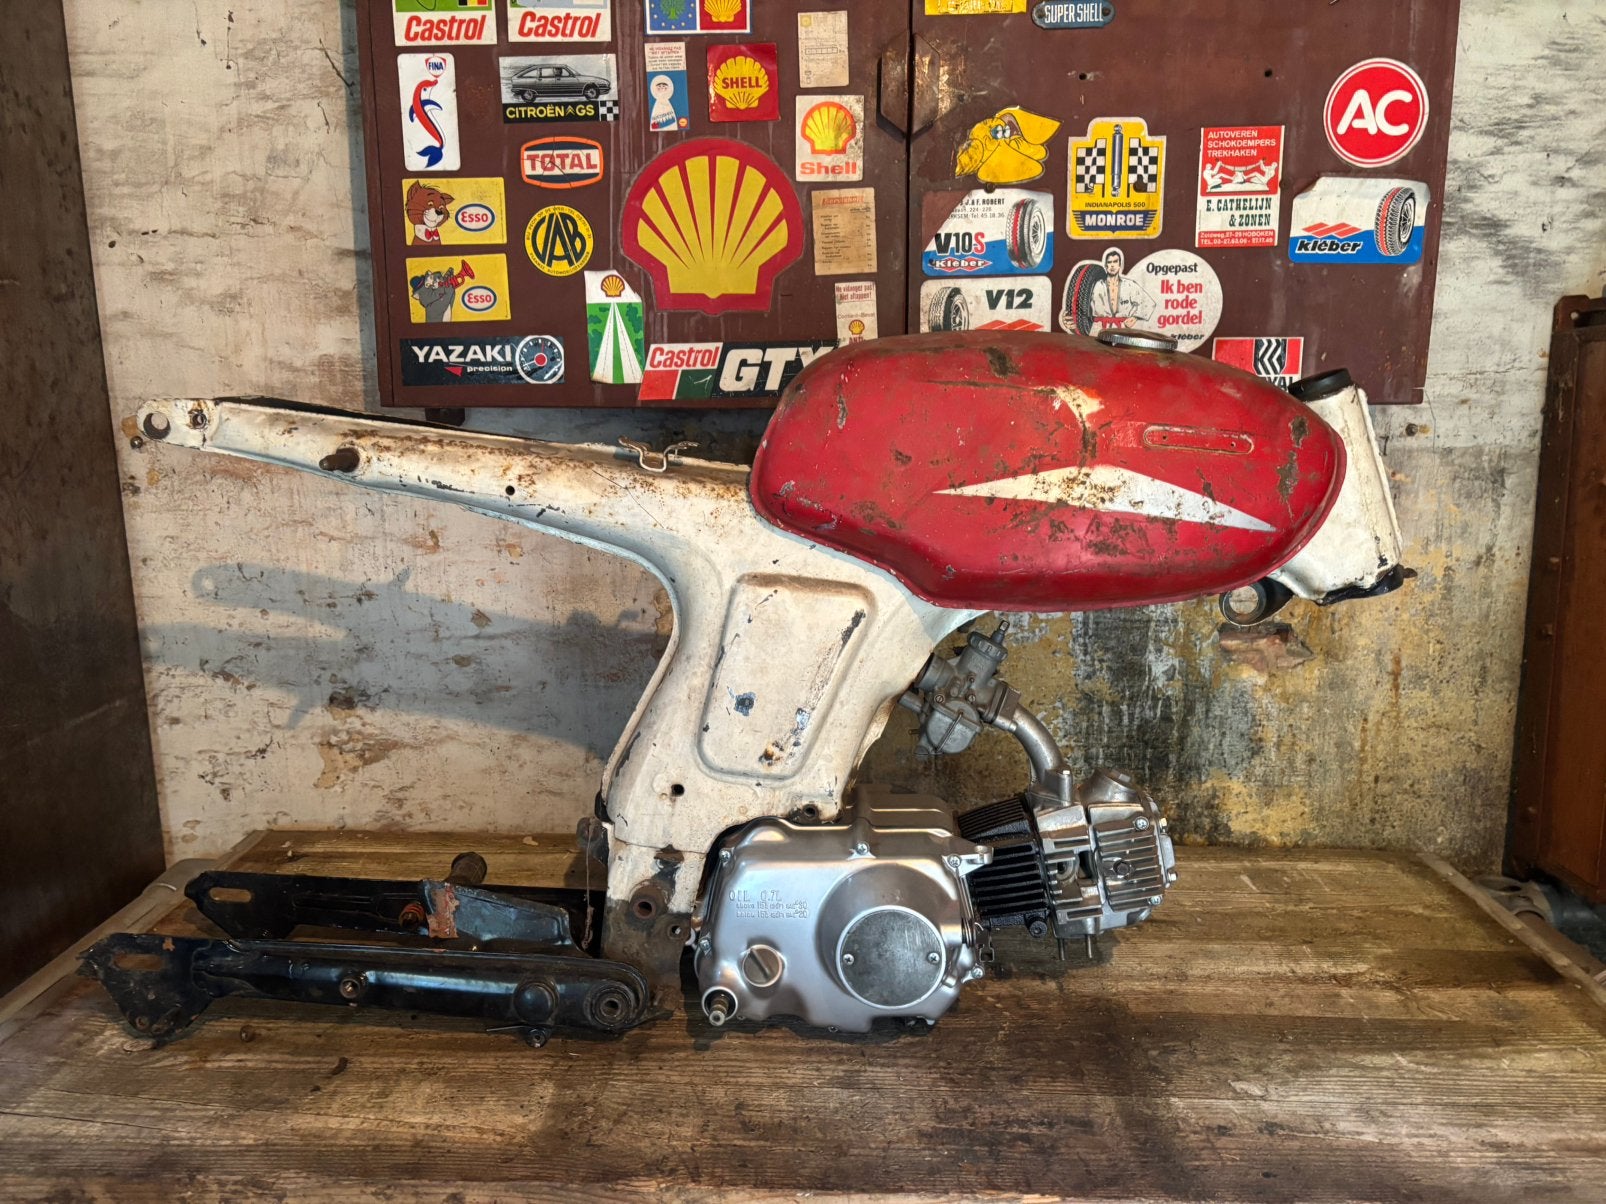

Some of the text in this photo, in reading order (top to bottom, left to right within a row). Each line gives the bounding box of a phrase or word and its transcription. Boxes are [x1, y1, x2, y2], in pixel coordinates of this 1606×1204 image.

[1044, 4, 1104, 23] SUPER SHELL
[405, 15, 487, 42] Castrol
[518, 11, 602, 38] Castrol
[428, 61, 444, 71] FINA
[722, 76, 763, 89] SHELL
[506, 103, 595, 119] CITROËN GS
[1336, 89, 1413, 136] AC
[1208, 130, 1258, 139] AUTOVEREN
[1207, 139, 1276, 148] SCHOKDEMPERS
[1207, 149, 1257, 157] TREKHAKEN
[527, 152, 598, 172] TOTAL
[800, 161, 857, 175] Shell
[1206, 197, 1272, 211] E. CATHELIJN
[461, 211, 489, 224] Esso
[1085, 213, 1144, 226] MONROE
[1229, 213, 1271, 227] & ZONEN
[532, 211, 587, 269] VAB
[1146, 262, 1198, 275] Opgepast
[1161, 279, 1203, 294] Ik ben
[467, 293, 492, 304] Esso
[986, 288, 1034, 310] V12
[1164, 295, 1198, 310] rode
[1157, 310, 1203, 329] gordel
[412, 345, 513, 363] YAZAKI
[650, 346, 720, 369] Castrol
[467, 365, 513, 373] precision
